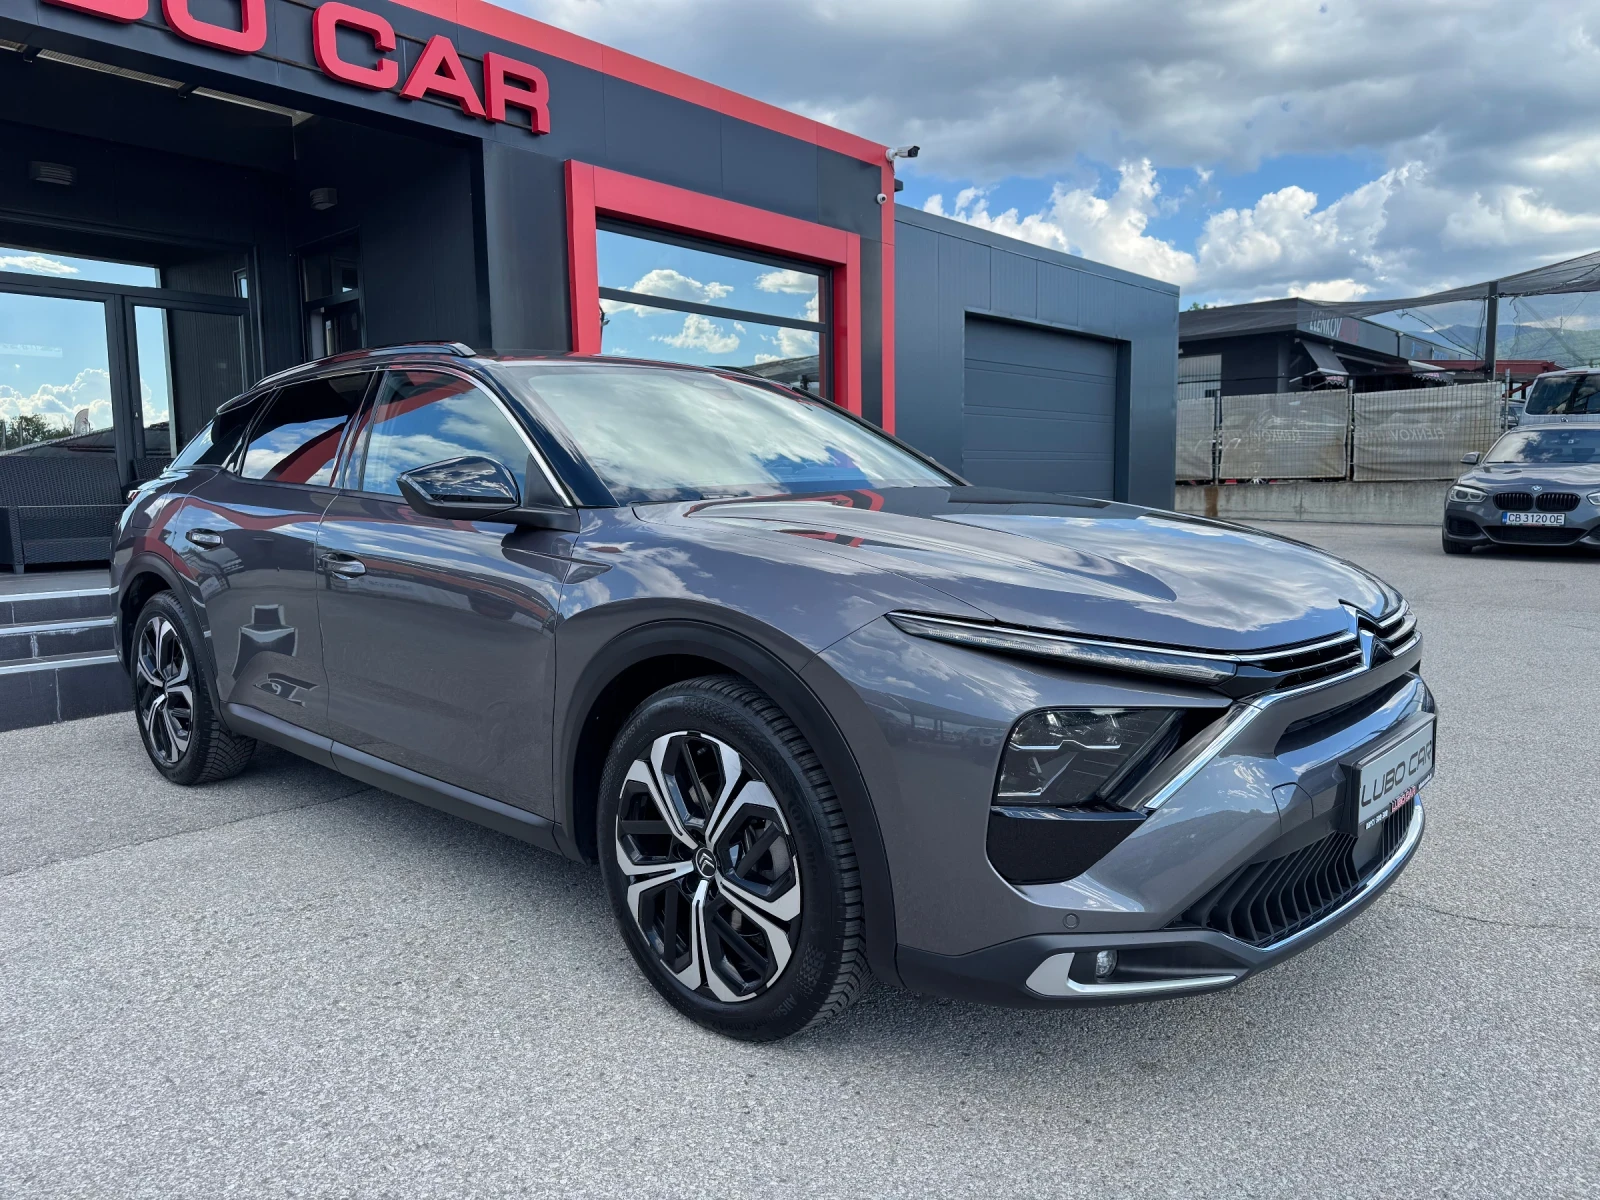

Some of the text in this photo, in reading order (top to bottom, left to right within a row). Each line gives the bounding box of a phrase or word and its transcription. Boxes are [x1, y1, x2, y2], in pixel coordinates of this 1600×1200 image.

[313, 1, 550, 136] CAR
[1508, 514, 1521, 522] CB
[1523, 514, 1547, 523] 3120
[1361, 760, 1405, 807] LUBO
[1408, 740, 1432, 776] CAR
[1391, 785, 1416, 813] LUBO CAR
